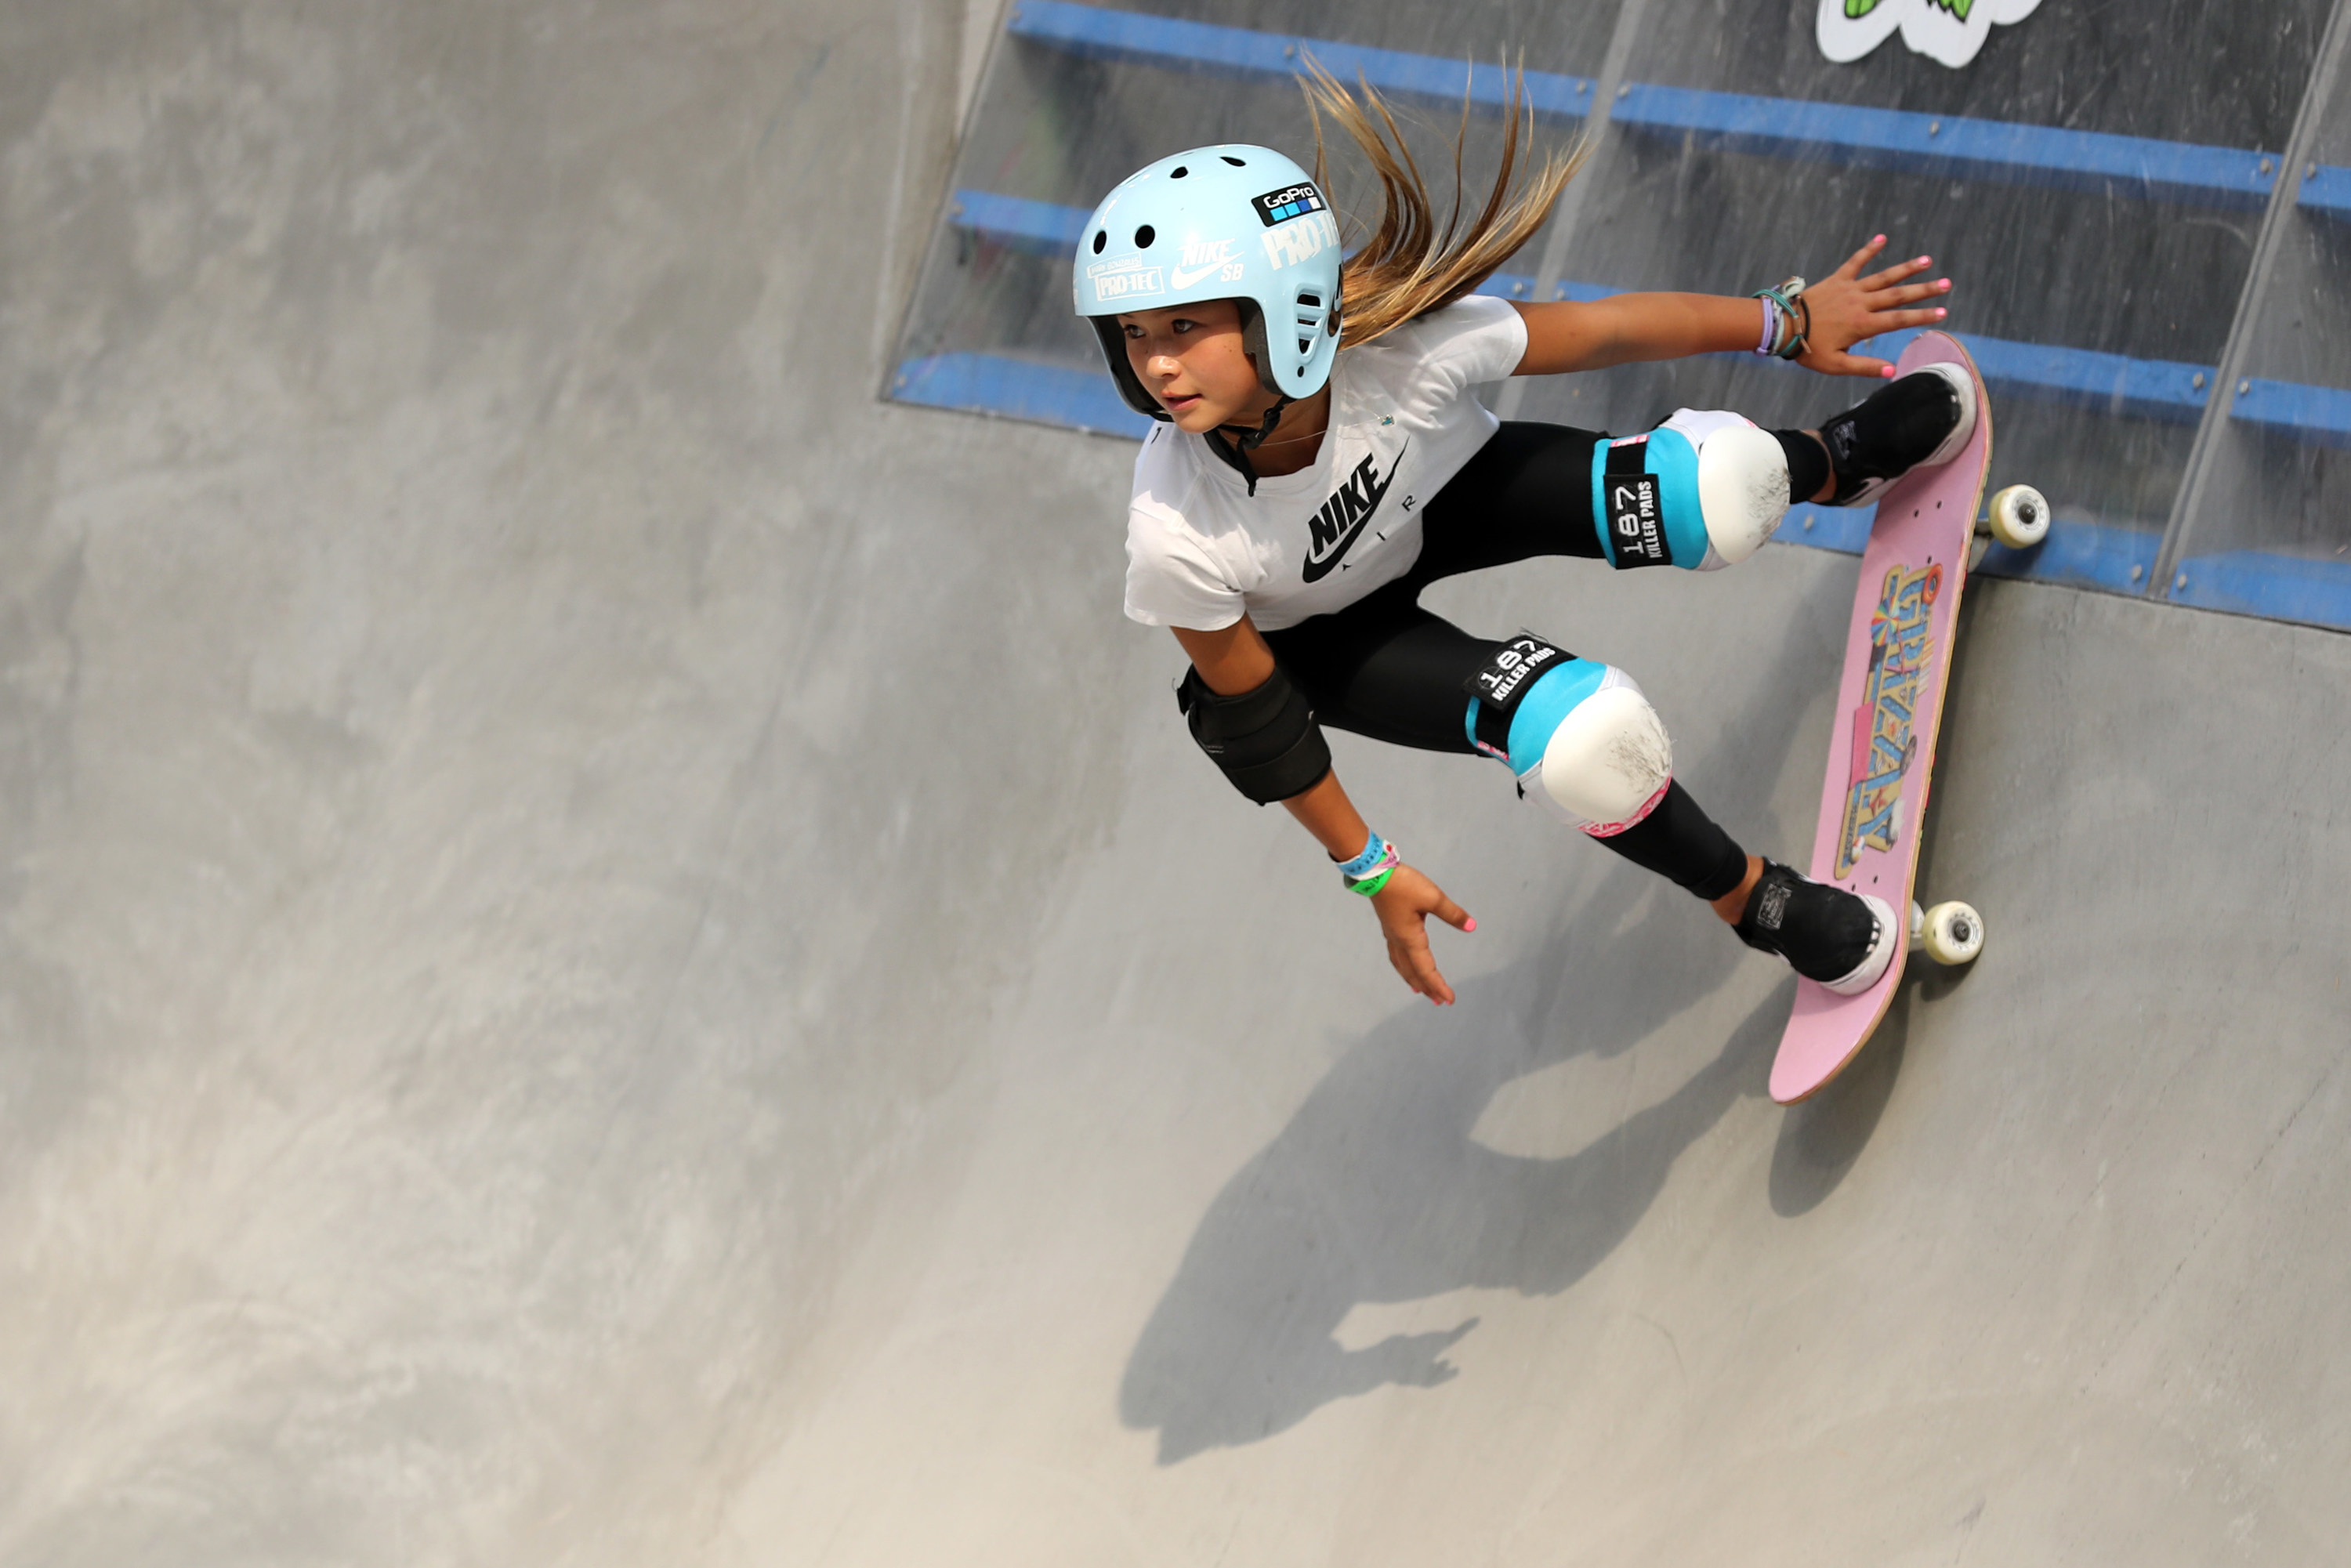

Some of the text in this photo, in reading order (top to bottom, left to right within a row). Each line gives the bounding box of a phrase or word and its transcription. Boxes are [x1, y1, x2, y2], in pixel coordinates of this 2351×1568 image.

[1263, 187, 1315, 208] GoPro
[1177, 237, 1236, 267] NIKE
[1260, 212, 1339, 271] PRO-TE
[1099, 270, 1158, 296] PRO-TEC
[1220, 263, 1244, 282] SB
[1308, 452, 1384, 558] NIKE
[1615, 486, 1644, 554] 187
[1638, 480, 1663, 558] KILLER PADS
[1480, 640, 1536, 688] 187
[1491, 647, 1556, 701] KILLER PADS
